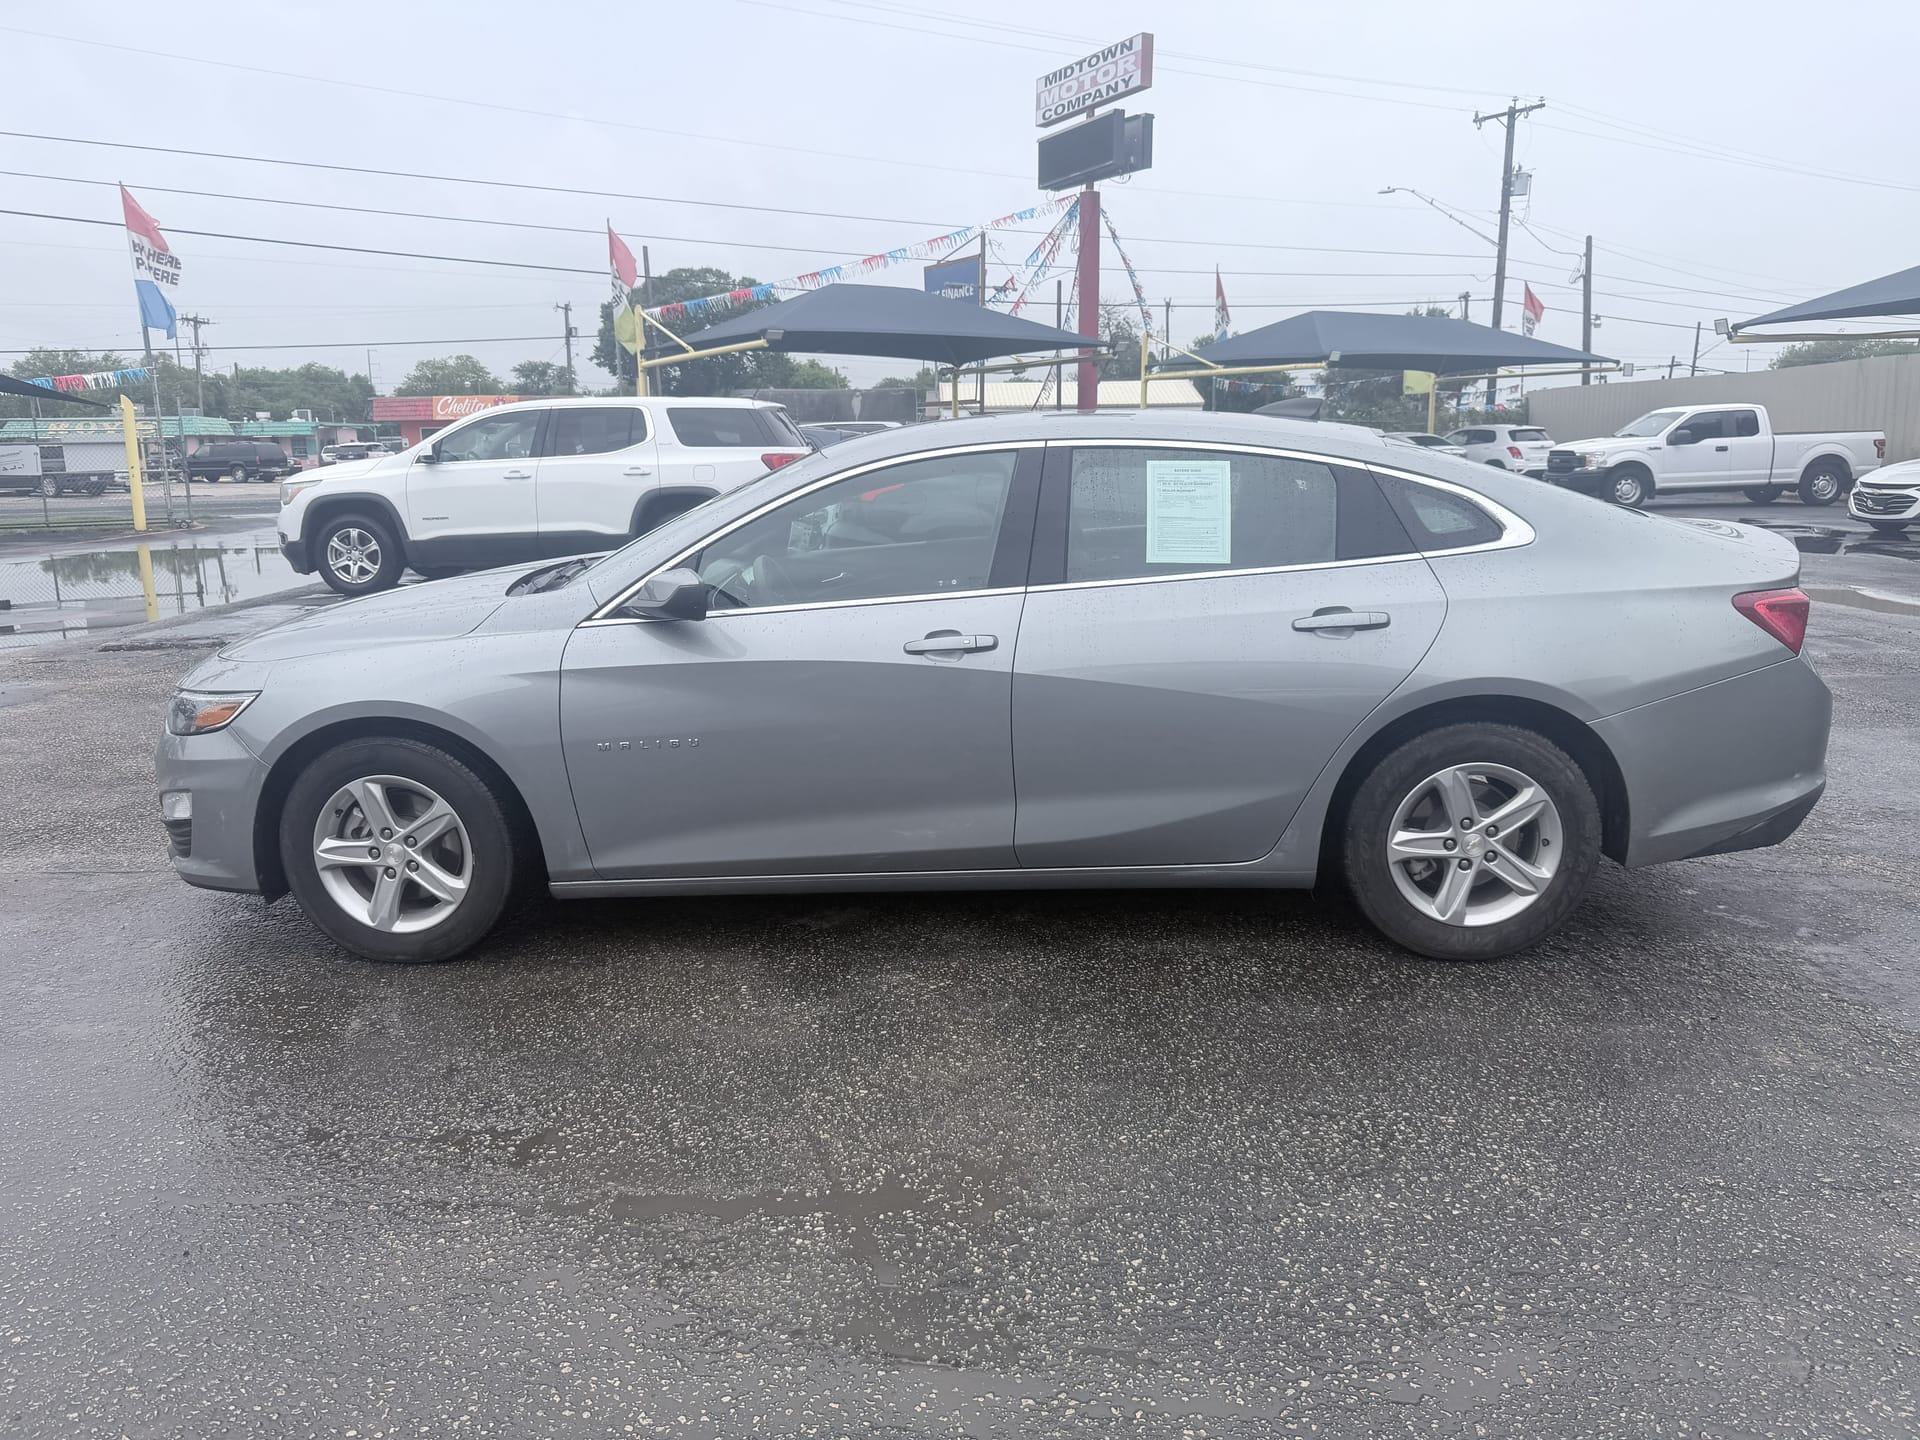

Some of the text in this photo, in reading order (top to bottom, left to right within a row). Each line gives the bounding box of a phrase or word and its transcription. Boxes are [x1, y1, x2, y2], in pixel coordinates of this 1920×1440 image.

[1040, 54, 1138, 109] MOTOR
[1044, 39, 1134, 88] MIDTOWN
[1042, 74, 1134, 121] COMPANY
[941, 285, 974, 300] FINANCE
[596, 738, 700, 752] MALIBU
